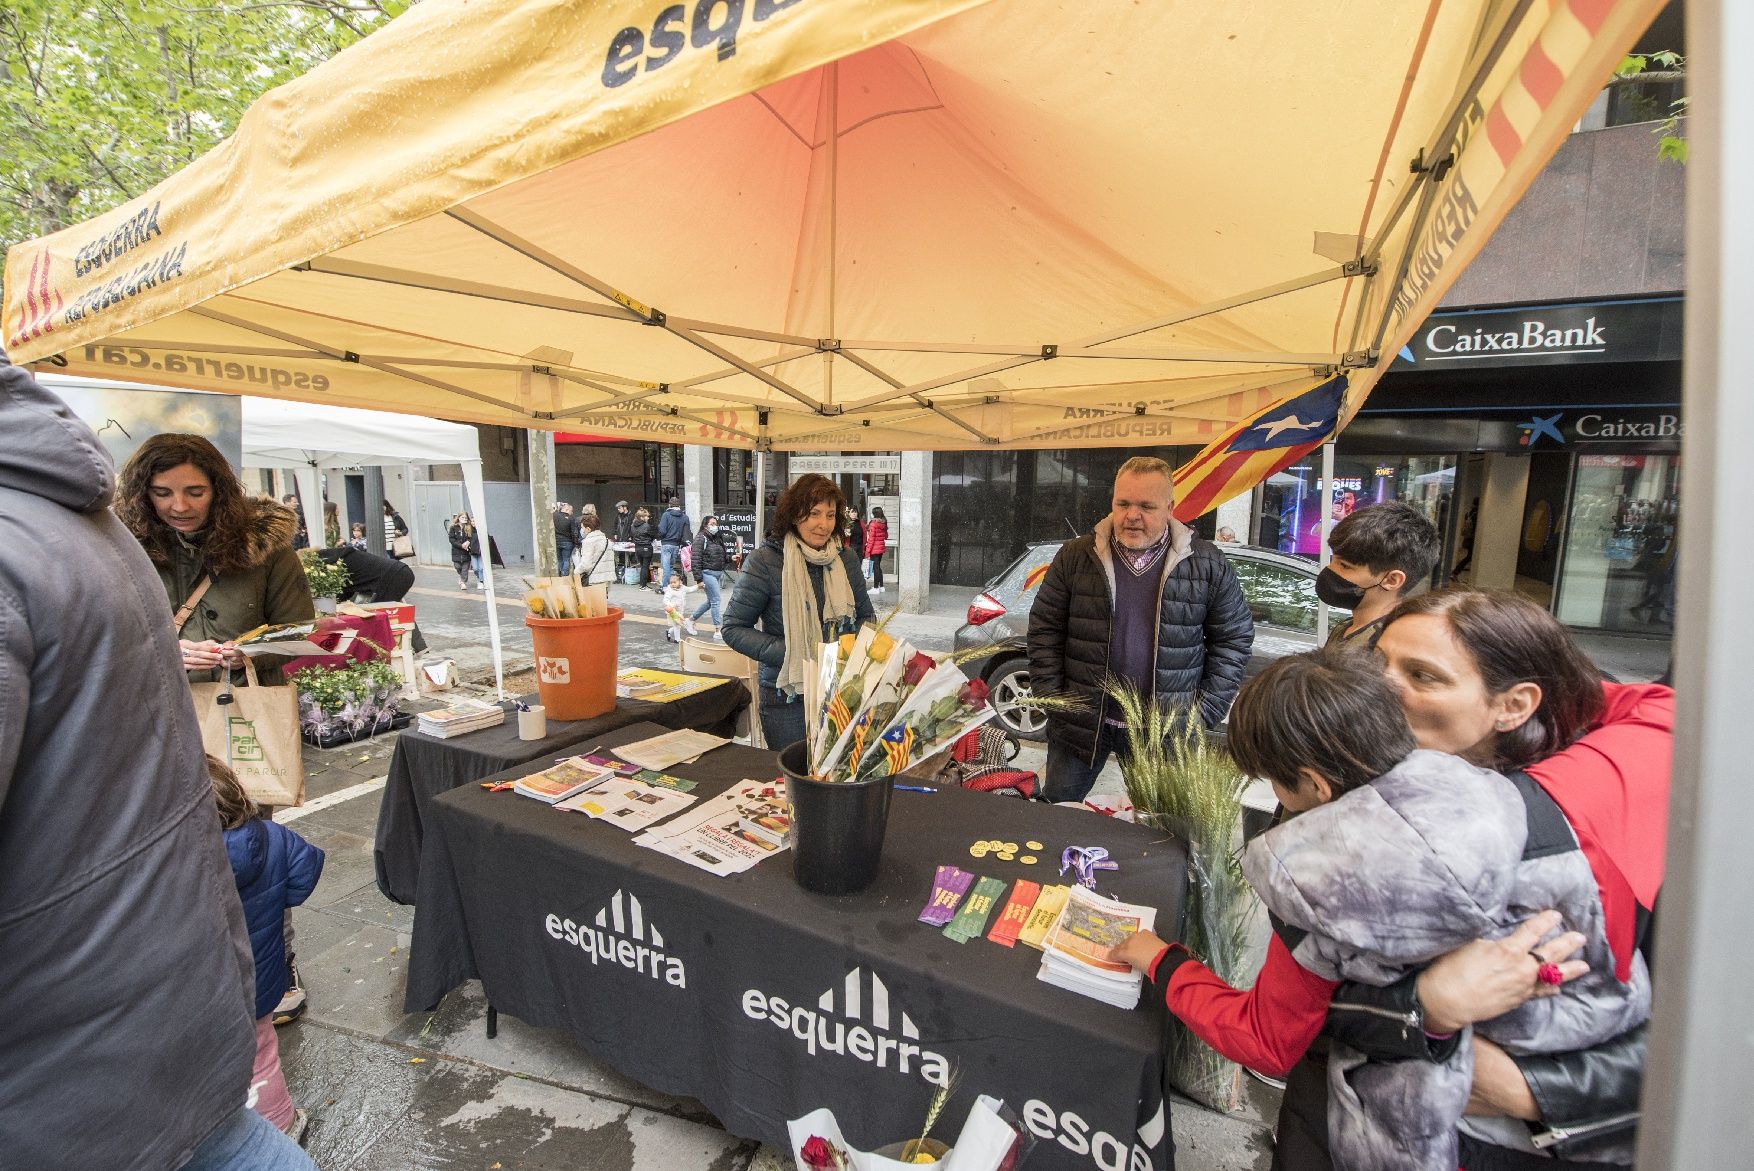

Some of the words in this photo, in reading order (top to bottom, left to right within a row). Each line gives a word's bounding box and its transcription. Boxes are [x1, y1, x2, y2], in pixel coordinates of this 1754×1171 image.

[75, 200, 162, 279] ESQUERRA
[64, 240, 188, 324] REPUBLICANA
[1426, 316, 1607, 353] CaixaBank
[791, 460, 840, 470] PASSEIG
[843, 460, 875, 470] PERE
[890, 459, 898, 470] 17
[545, 913, 687, 989] esquerra
[742, 989, 950, 1089] esquerra
